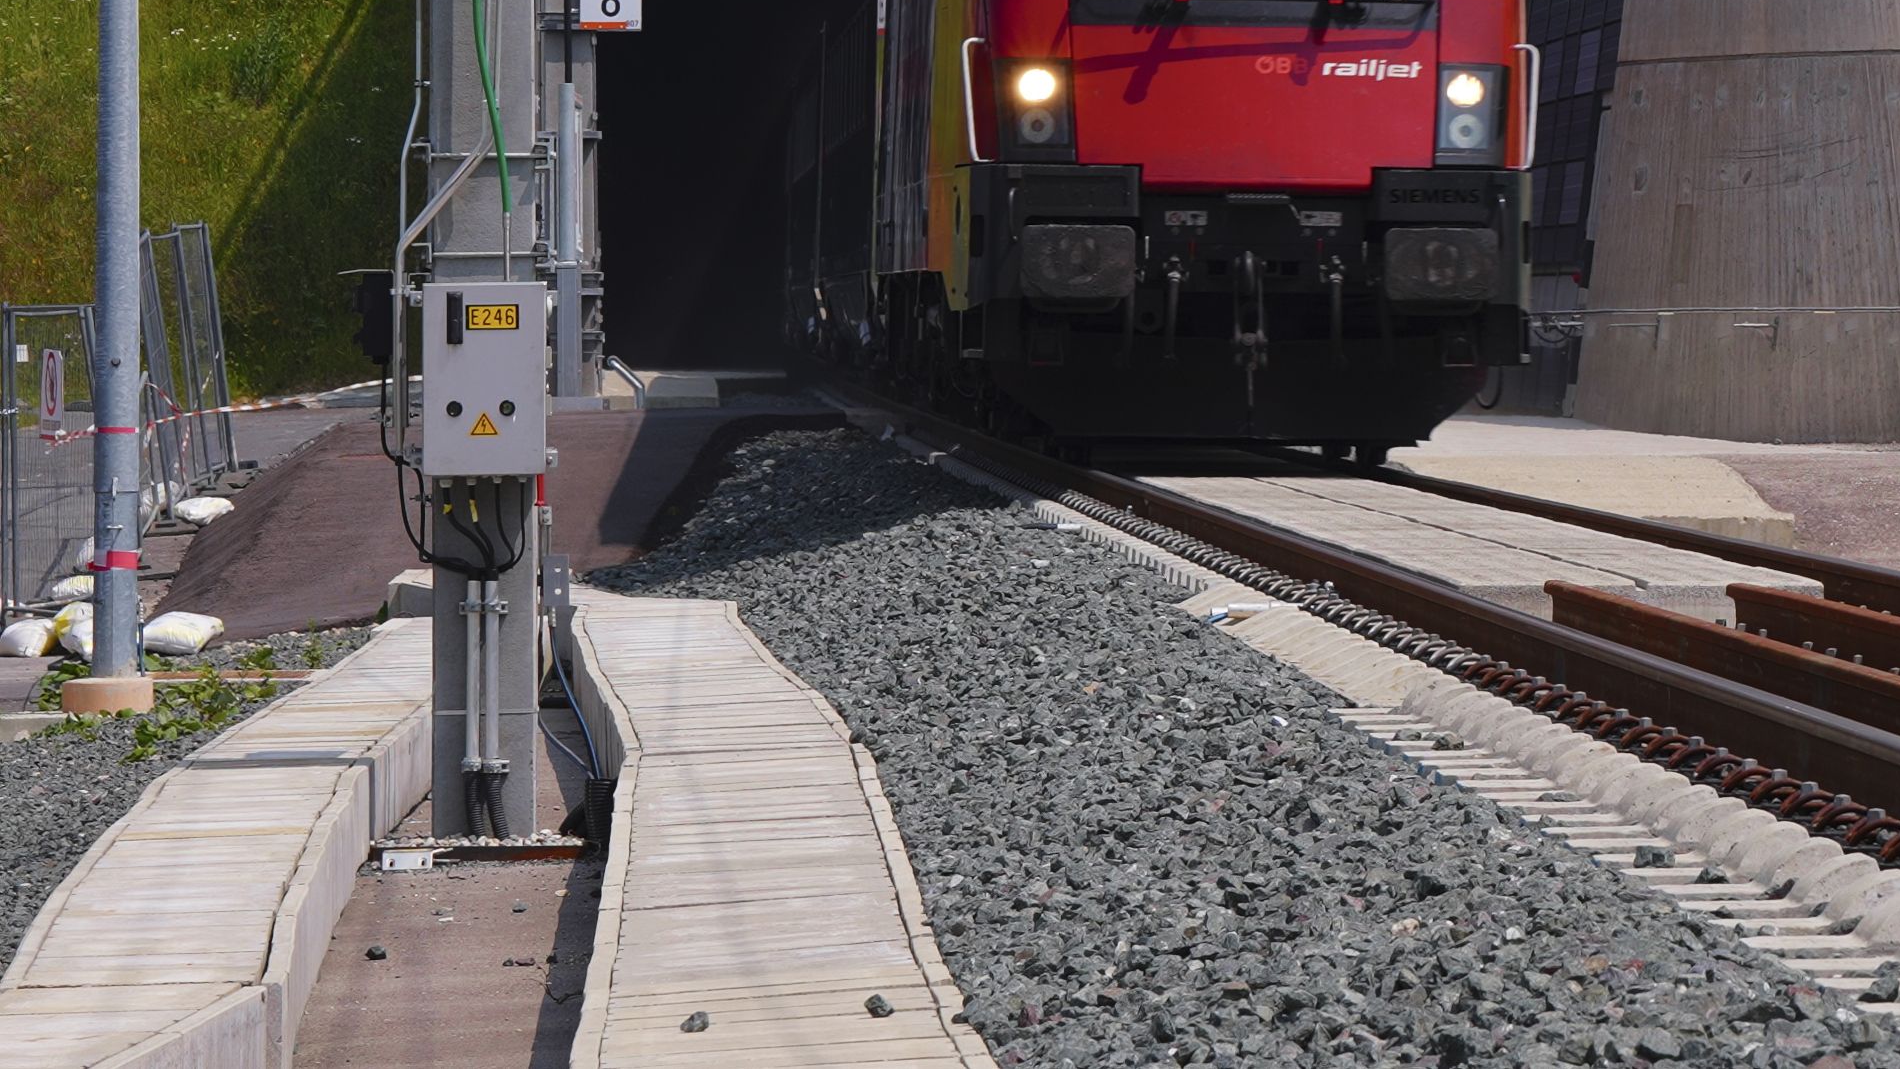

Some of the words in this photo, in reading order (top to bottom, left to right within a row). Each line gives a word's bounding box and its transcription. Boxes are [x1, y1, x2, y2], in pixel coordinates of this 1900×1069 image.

[1321, 58, 1423, 81] railjet
[1389, 188, 1481, 204] SIEMENS
[471, 308, 515, 326] E246
